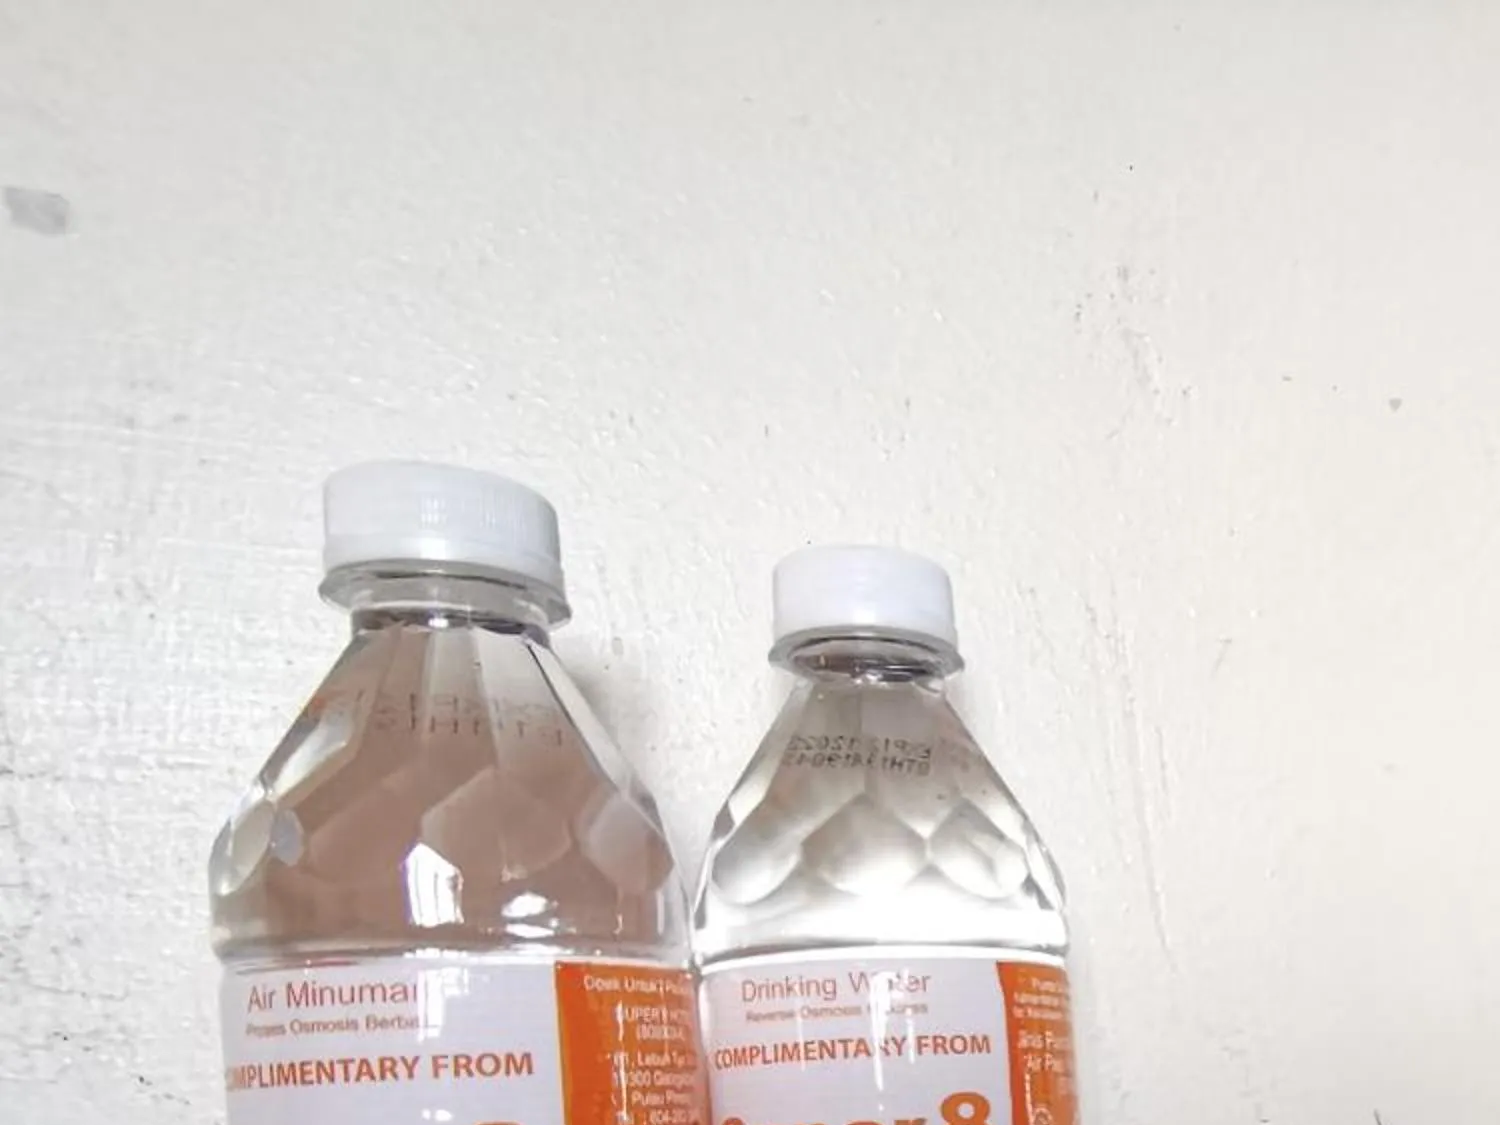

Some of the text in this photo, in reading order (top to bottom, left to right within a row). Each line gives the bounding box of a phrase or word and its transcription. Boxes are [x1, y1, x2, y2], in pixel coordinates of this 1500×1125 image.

[247, 985, 277, 1013] Air
[741, 971, 931, 1003] Drinking Wter
[289, 1017, 360, 1036] Osmosis
[365, 1013, 424, 1032] Berba
[916, 1034, 992, 1057] FROM
[226, 1051, 535, 1092] MPLIMENTARY FROM
